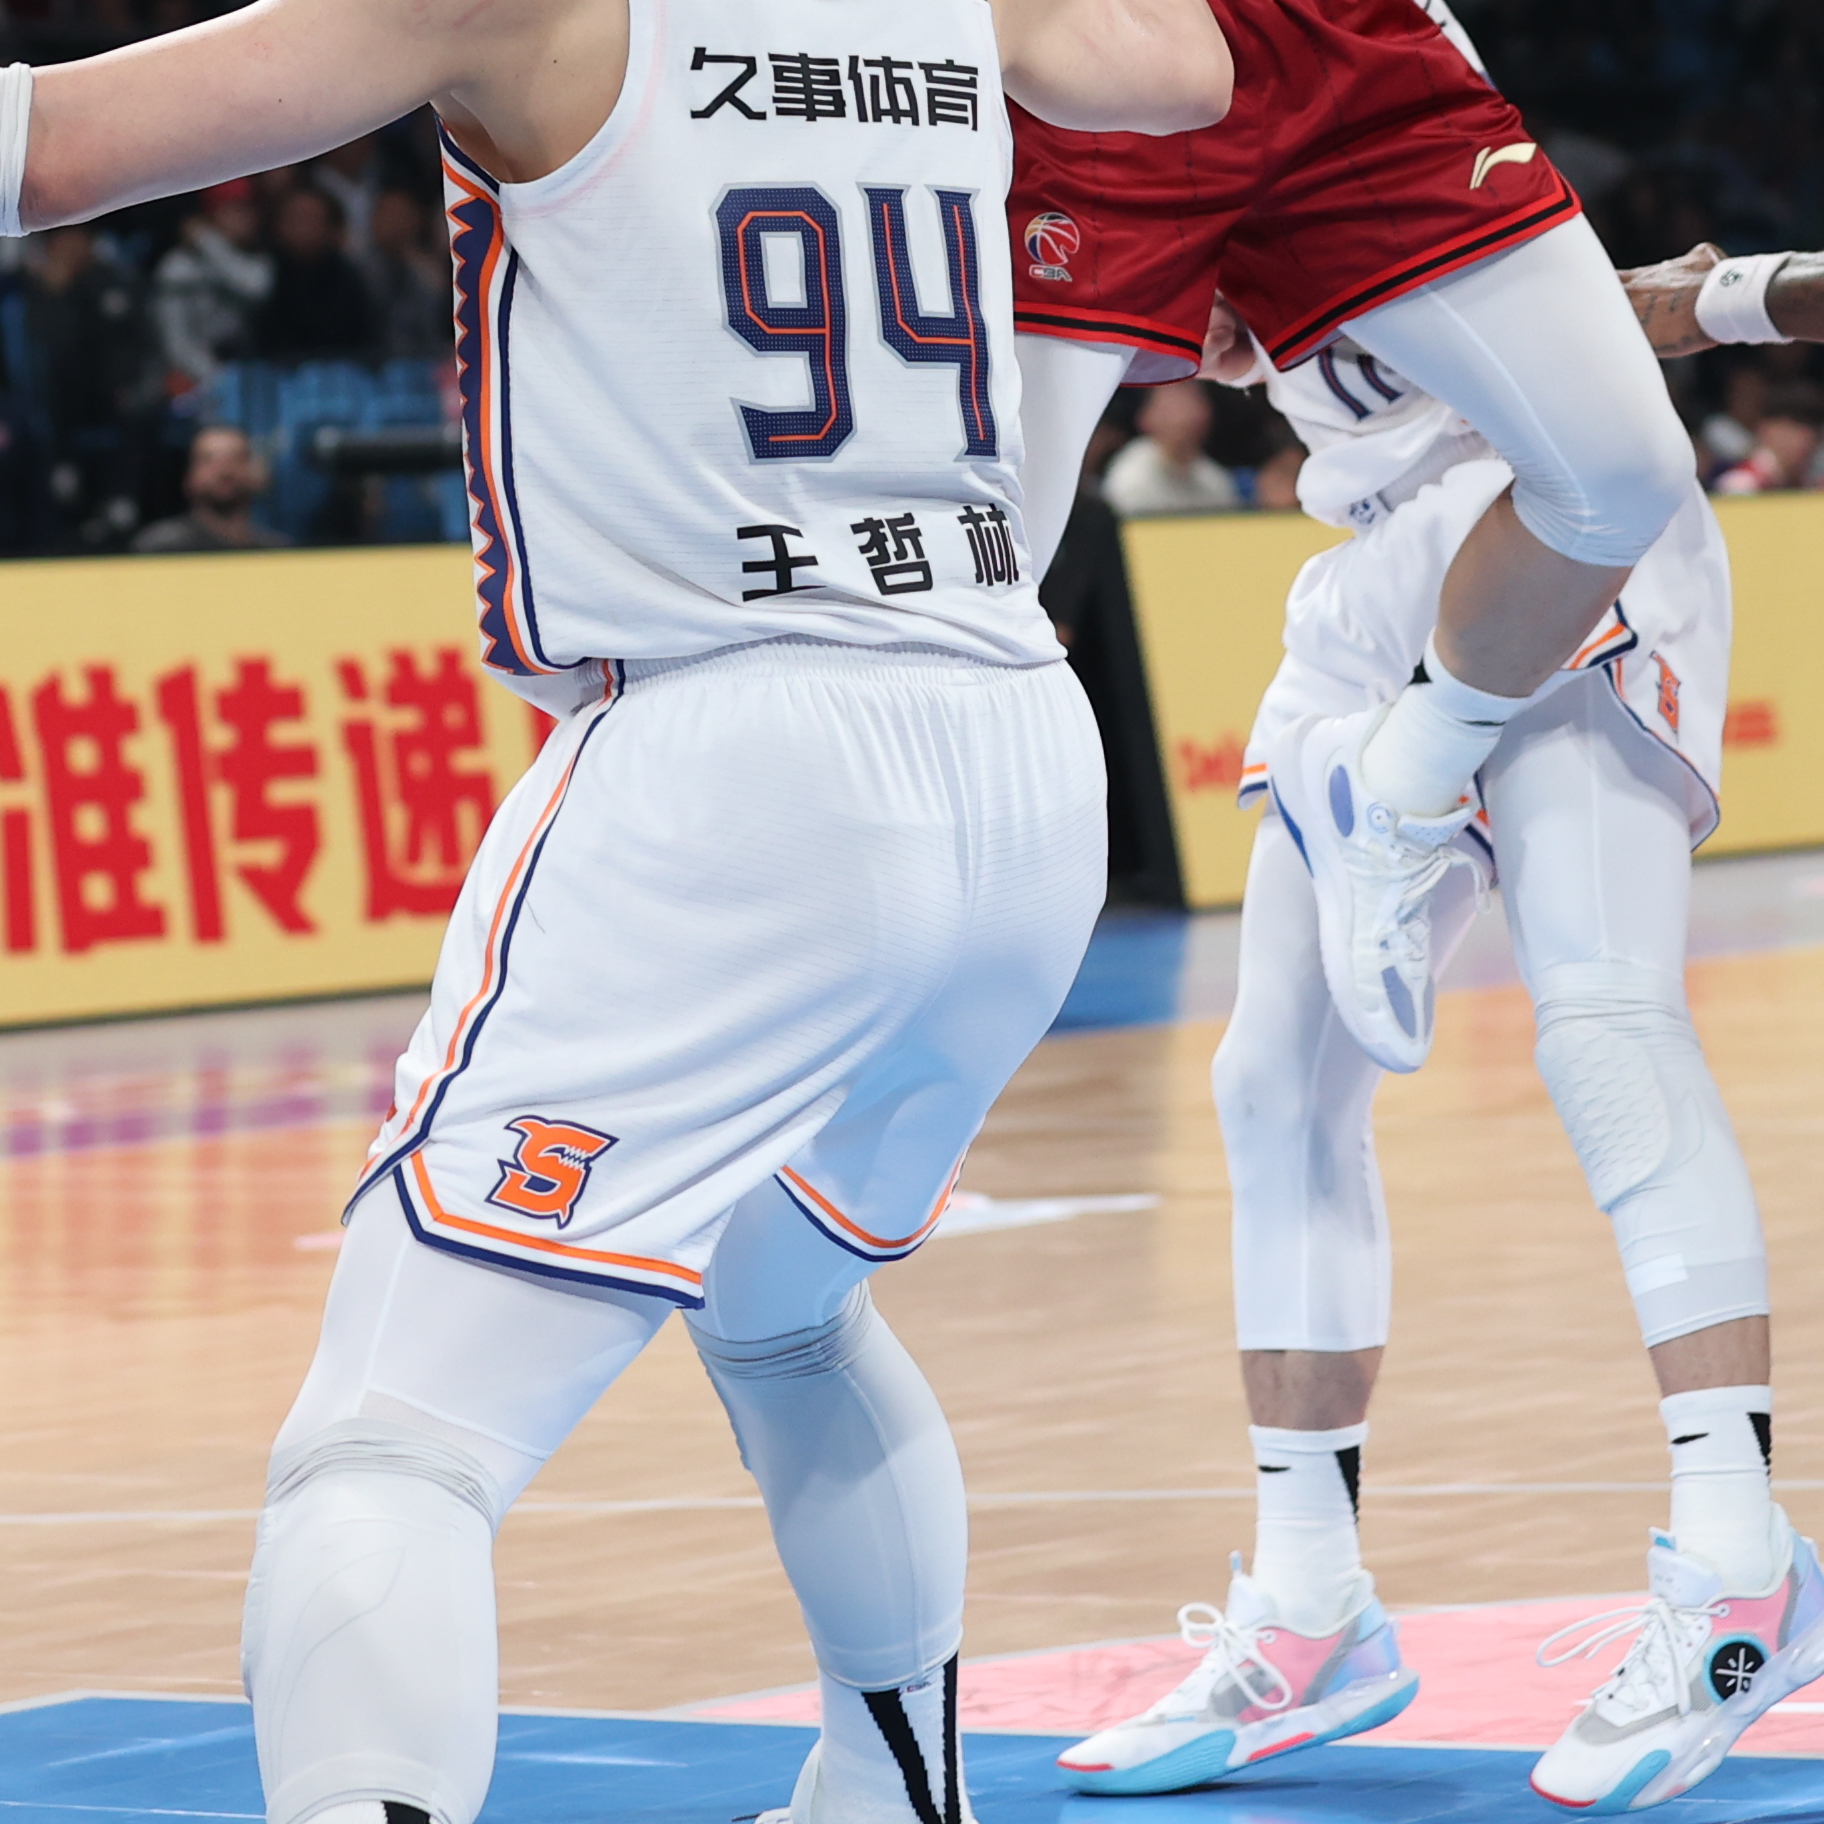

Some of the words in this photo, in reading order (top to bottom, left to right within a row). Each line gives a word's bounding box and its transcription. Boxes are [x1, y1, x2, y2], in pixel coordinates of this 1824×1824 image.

[689, 46, 979, 132] 久事体育
[1028, 264, 1073, 283] CBA
[708, 180, 1004, 466] 94
[737, 502, 1019, 602] 王哲林
